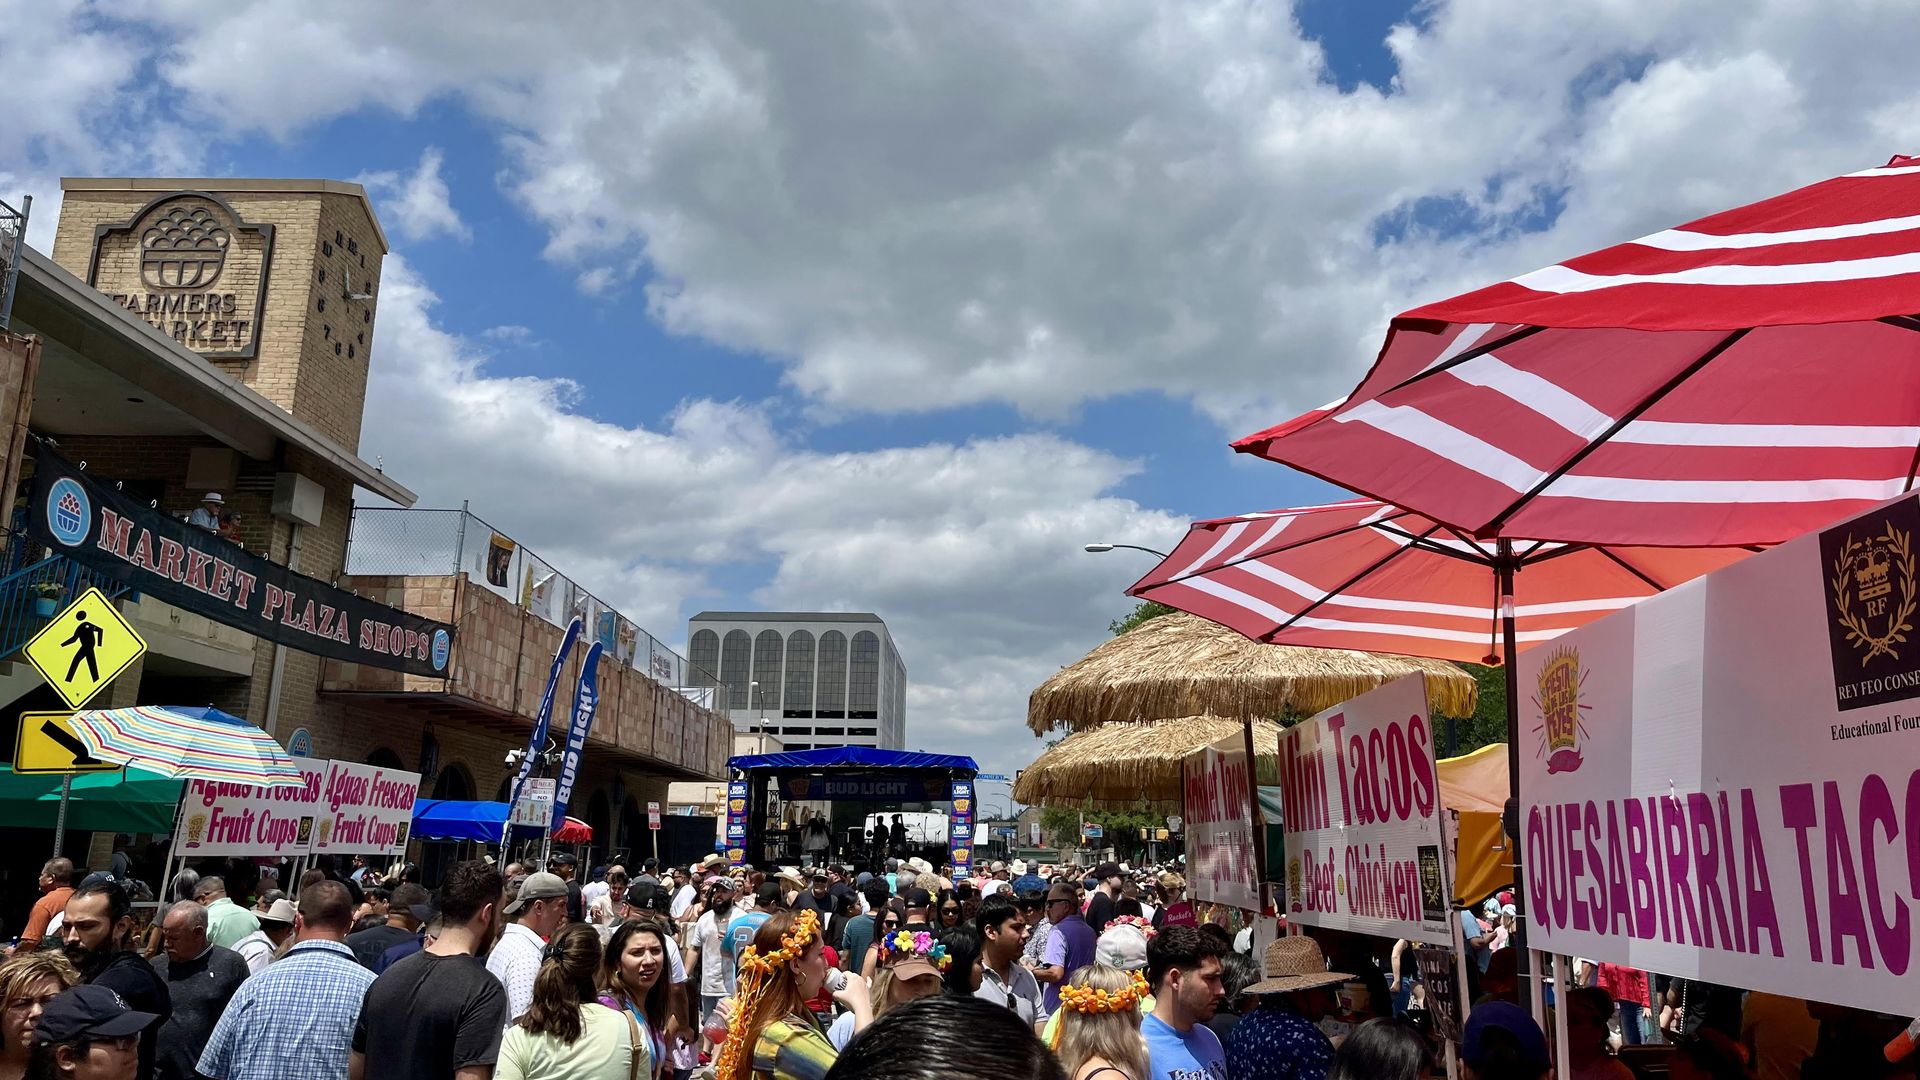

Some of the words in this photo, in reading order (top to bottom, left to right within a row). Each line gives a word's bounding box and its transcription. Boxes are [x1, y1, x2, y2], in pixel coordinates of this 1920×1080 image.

[106, 293, 236, 314] FARMERS
[148, 320, 250, 342] ARKET
[324, 324, 330, 340] 7
[97, 506, 257, 610] MARKET
[262, 583, 350, 644] PLAZA
[359, 618, 429, 661] SHOPS
[1866, 597, 1887, 618] RF
[1545, 662, 1570, 697] FIESTA
[1838, 683, 1859, 700] REY
[1861, 678, 1882, 696] FEO
[557, 752, 580, 805] BUD
[570, 680, 595, 751] LIGHT
[1547, 704, 1573, 743] REYES
[1831, 716, 1892, 741] Educational
[323, 764, 369, 813] Aguas
[367, 771, 417, 811] Frescas
[825, 782, 859, 794] BUD
[861, 782, 908, 795] LIGHT
[1185, 759, 1220, 825] Brisket
[1278, 721, 1330, 834] Mini
[1327, 712, 1434, 826] Tacos
[206, 806, 255, 844] Fruit
[256, 809, 298, 851] Cups
[331, 812, 367, 844] Fruit
[366, 815, 397, 851] Cups
[1304, 846, 1337, 913] Beef
[1345, 843, 1421, 922] Chicken
[1527, 788, 1784, 958] QUESABIRRIA
[1779, 769, 1920, 976] TAC
